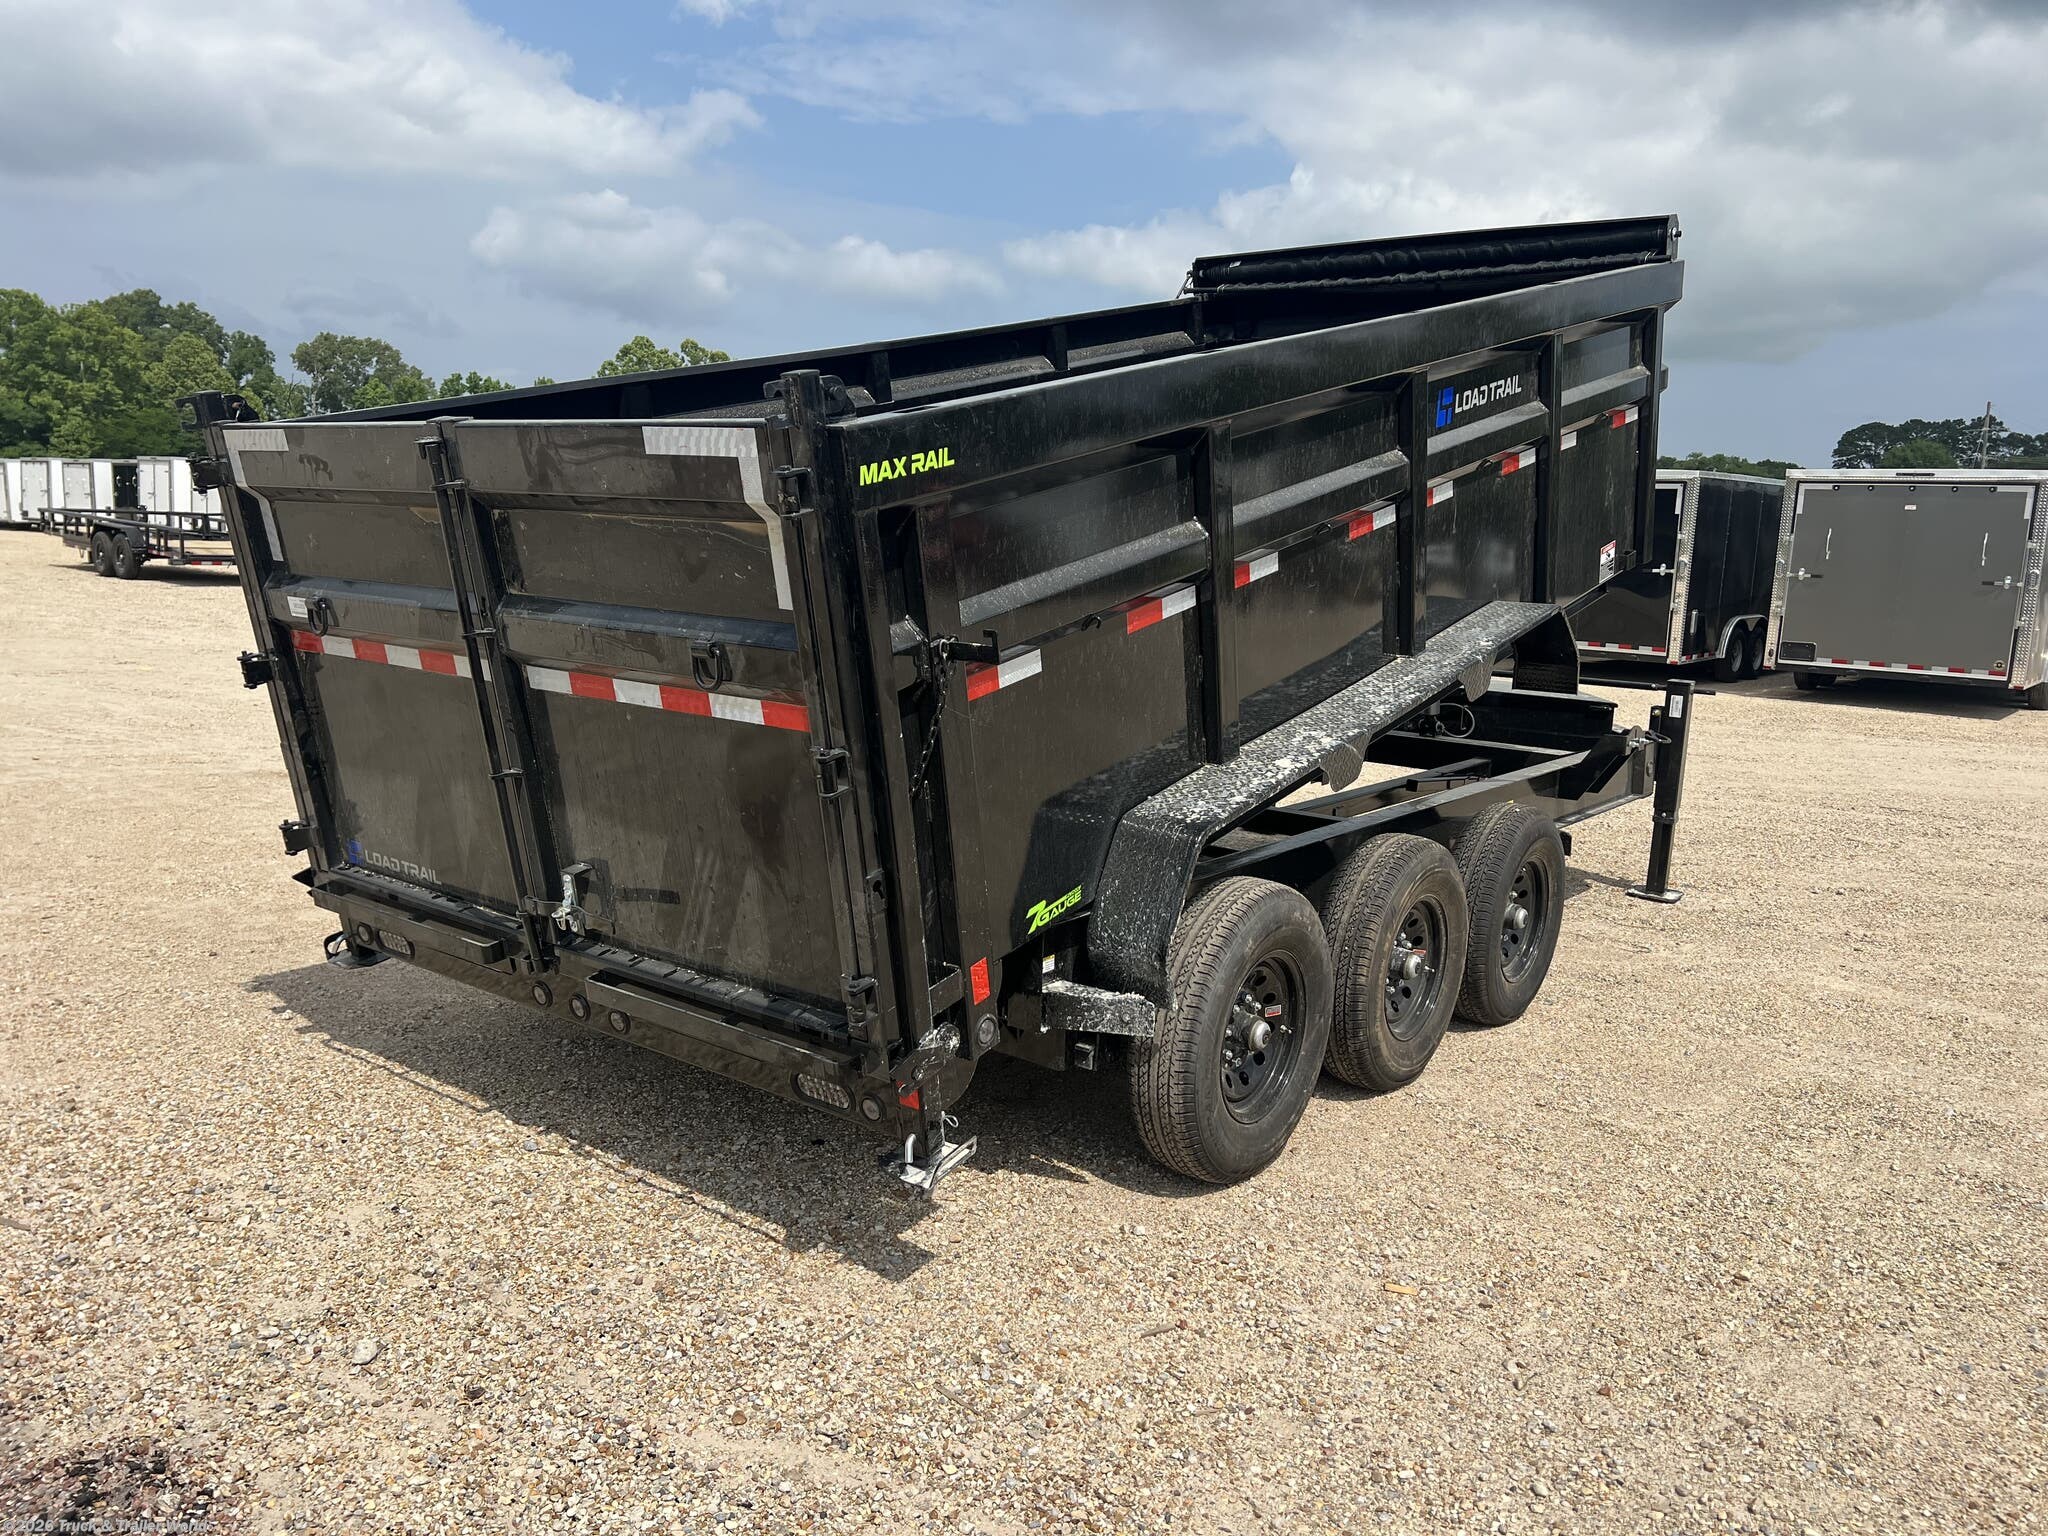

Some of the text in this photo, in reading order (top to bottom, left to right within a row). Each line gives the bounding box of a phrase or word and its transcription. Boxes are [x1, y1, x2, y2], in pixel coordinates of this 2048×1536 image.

[859, 447, 955, 486] MAX RAIL
[1036, 889, 1082, 927] GAUGE
